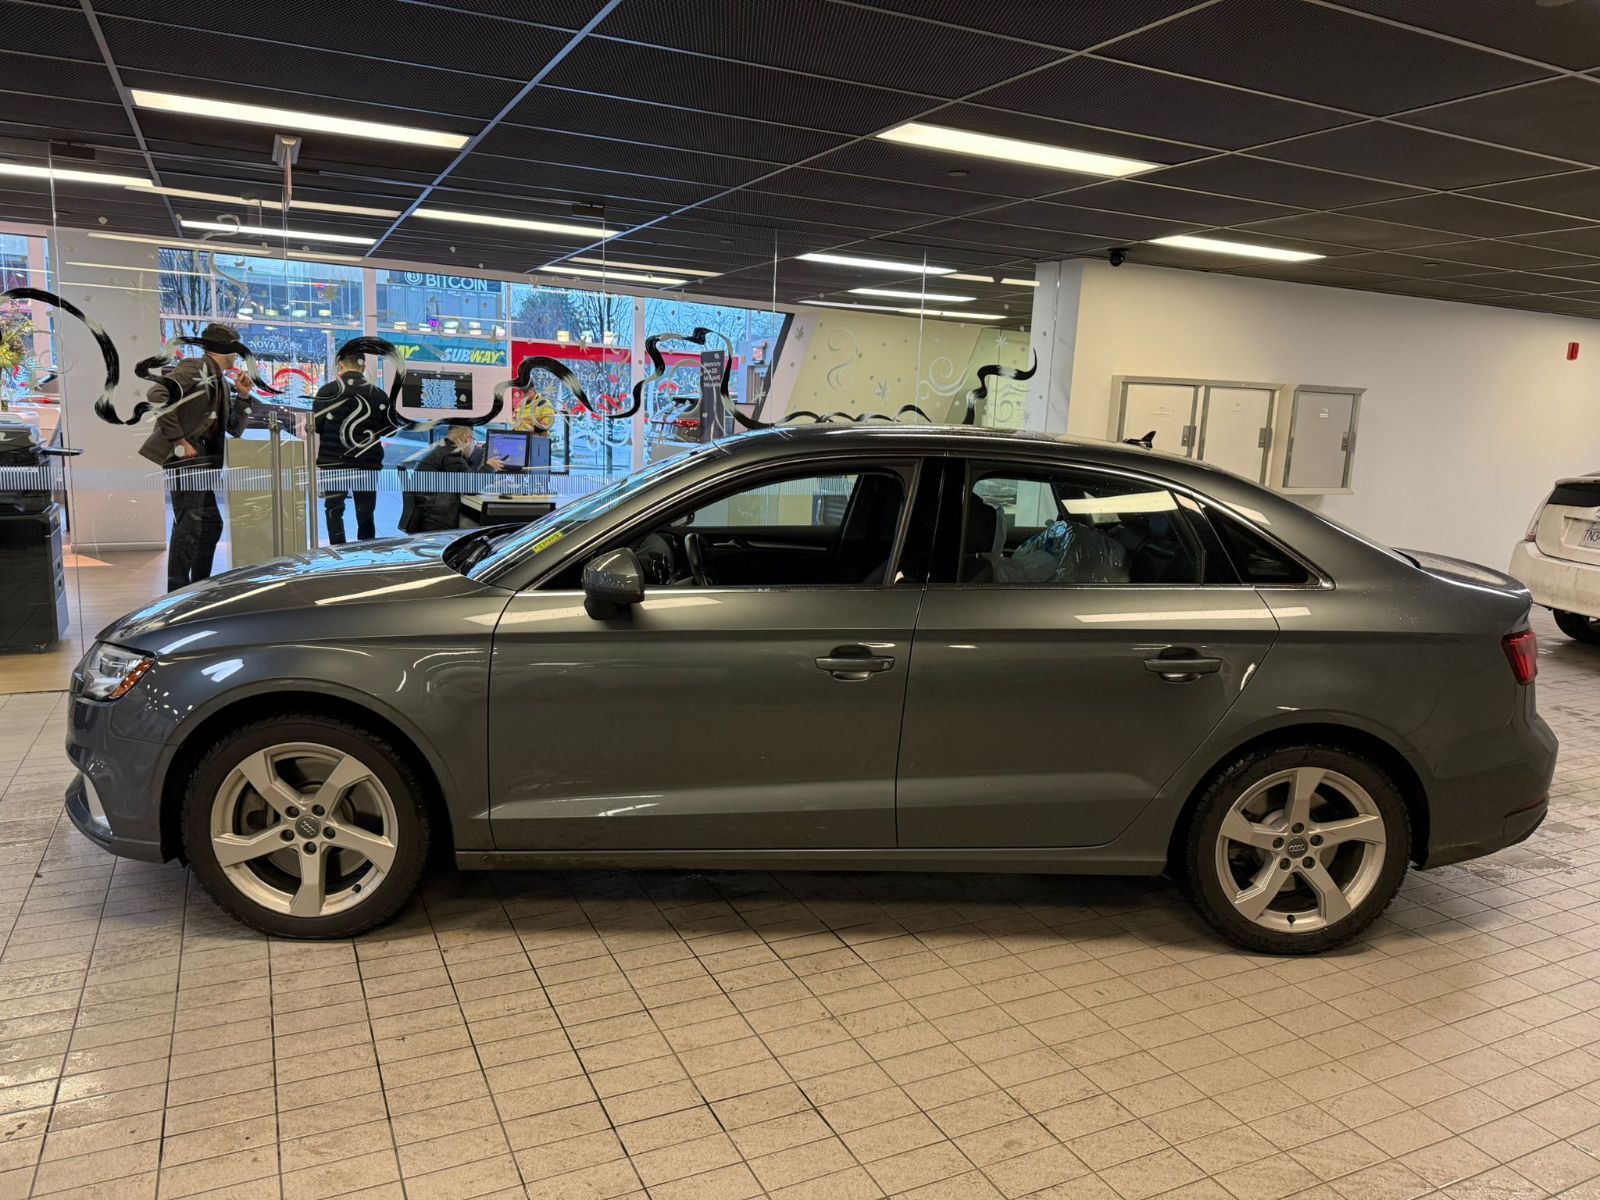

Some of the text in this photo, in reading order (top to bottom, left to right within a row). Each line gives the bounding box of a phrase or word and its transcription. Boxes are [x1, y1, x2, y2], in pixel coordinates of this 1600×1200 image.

[426, 273, 488, 291] BITCOIN
[249, 340, 276, 349] NOVA
[441, 347, 505, 364] SUBWAY
